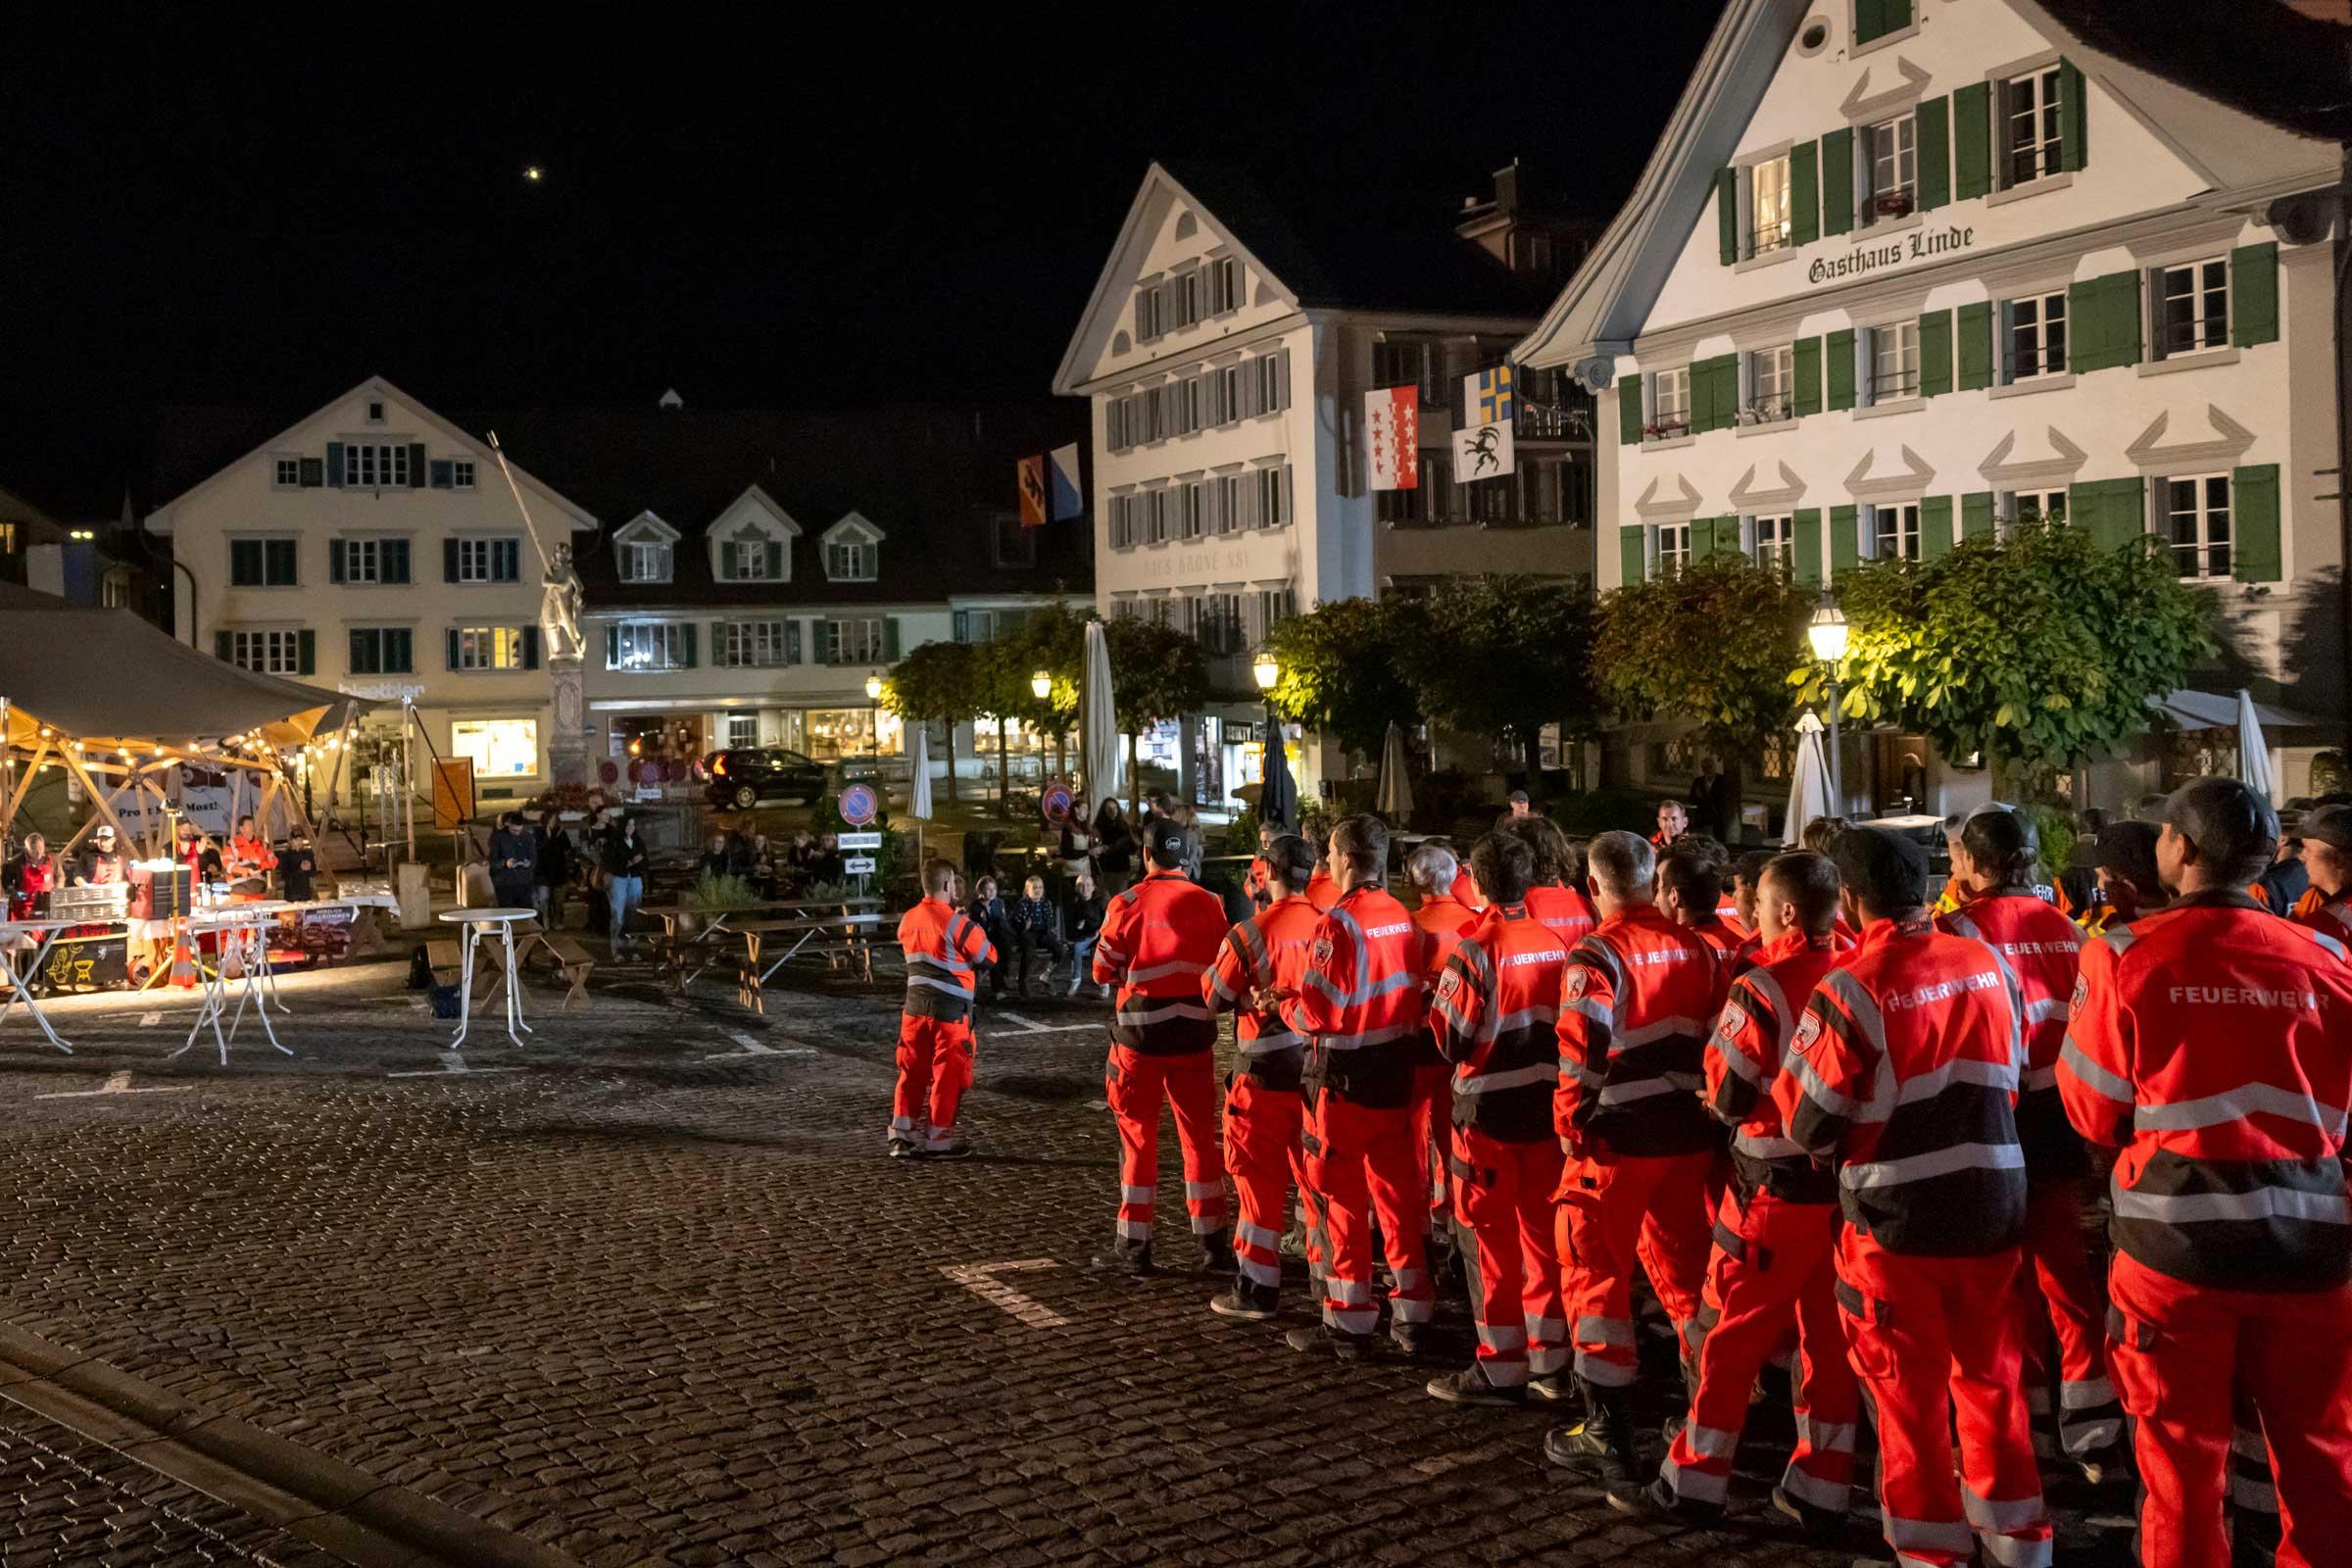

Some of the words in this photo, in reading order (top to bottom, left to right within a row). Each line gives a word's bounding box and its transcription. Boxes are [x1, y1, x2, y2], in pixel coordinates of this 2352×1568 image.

[1809, 241, 1903, 283] Gasthaus
[1909, 225, 1974, 260] Linde
[119, 808, 152, 818] Prot
[186, 801, 218, 811] Most!
[1886, 971, 1999, 1012] FEUERWEHR
[2169, 986, 2329, 1011] FEUERWEHR
